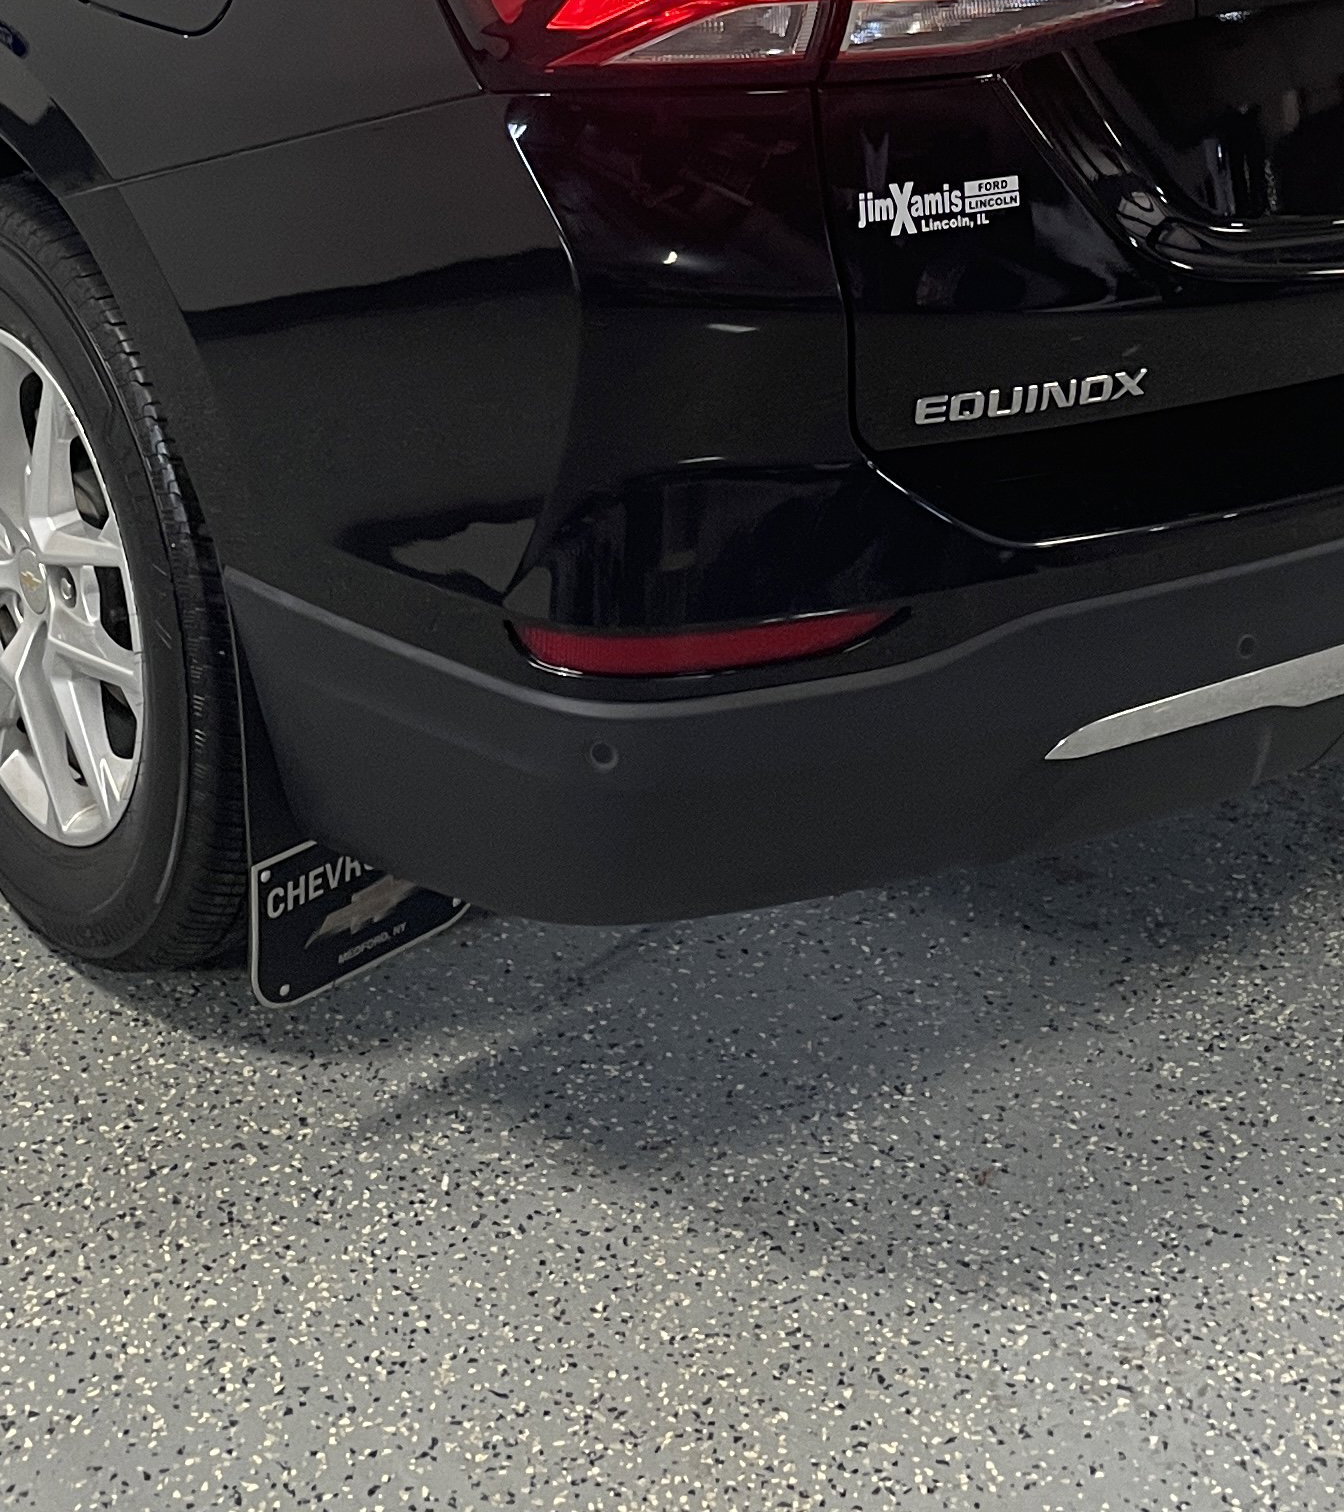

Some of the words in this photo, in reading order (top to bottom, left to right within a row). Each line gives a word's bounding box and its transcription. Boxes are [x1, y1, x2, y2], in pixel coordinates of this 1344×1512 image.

[978, 179, 1008, 192] FORD
[968, 193, 1018, 210] LINCOLN
[921, 216, 974, 232] Lincoln,
[976, 214, 989, 226] IL
[914, 368, 1148, 425] EQUINOX
[267, 856, 374, 918] CHEVR
